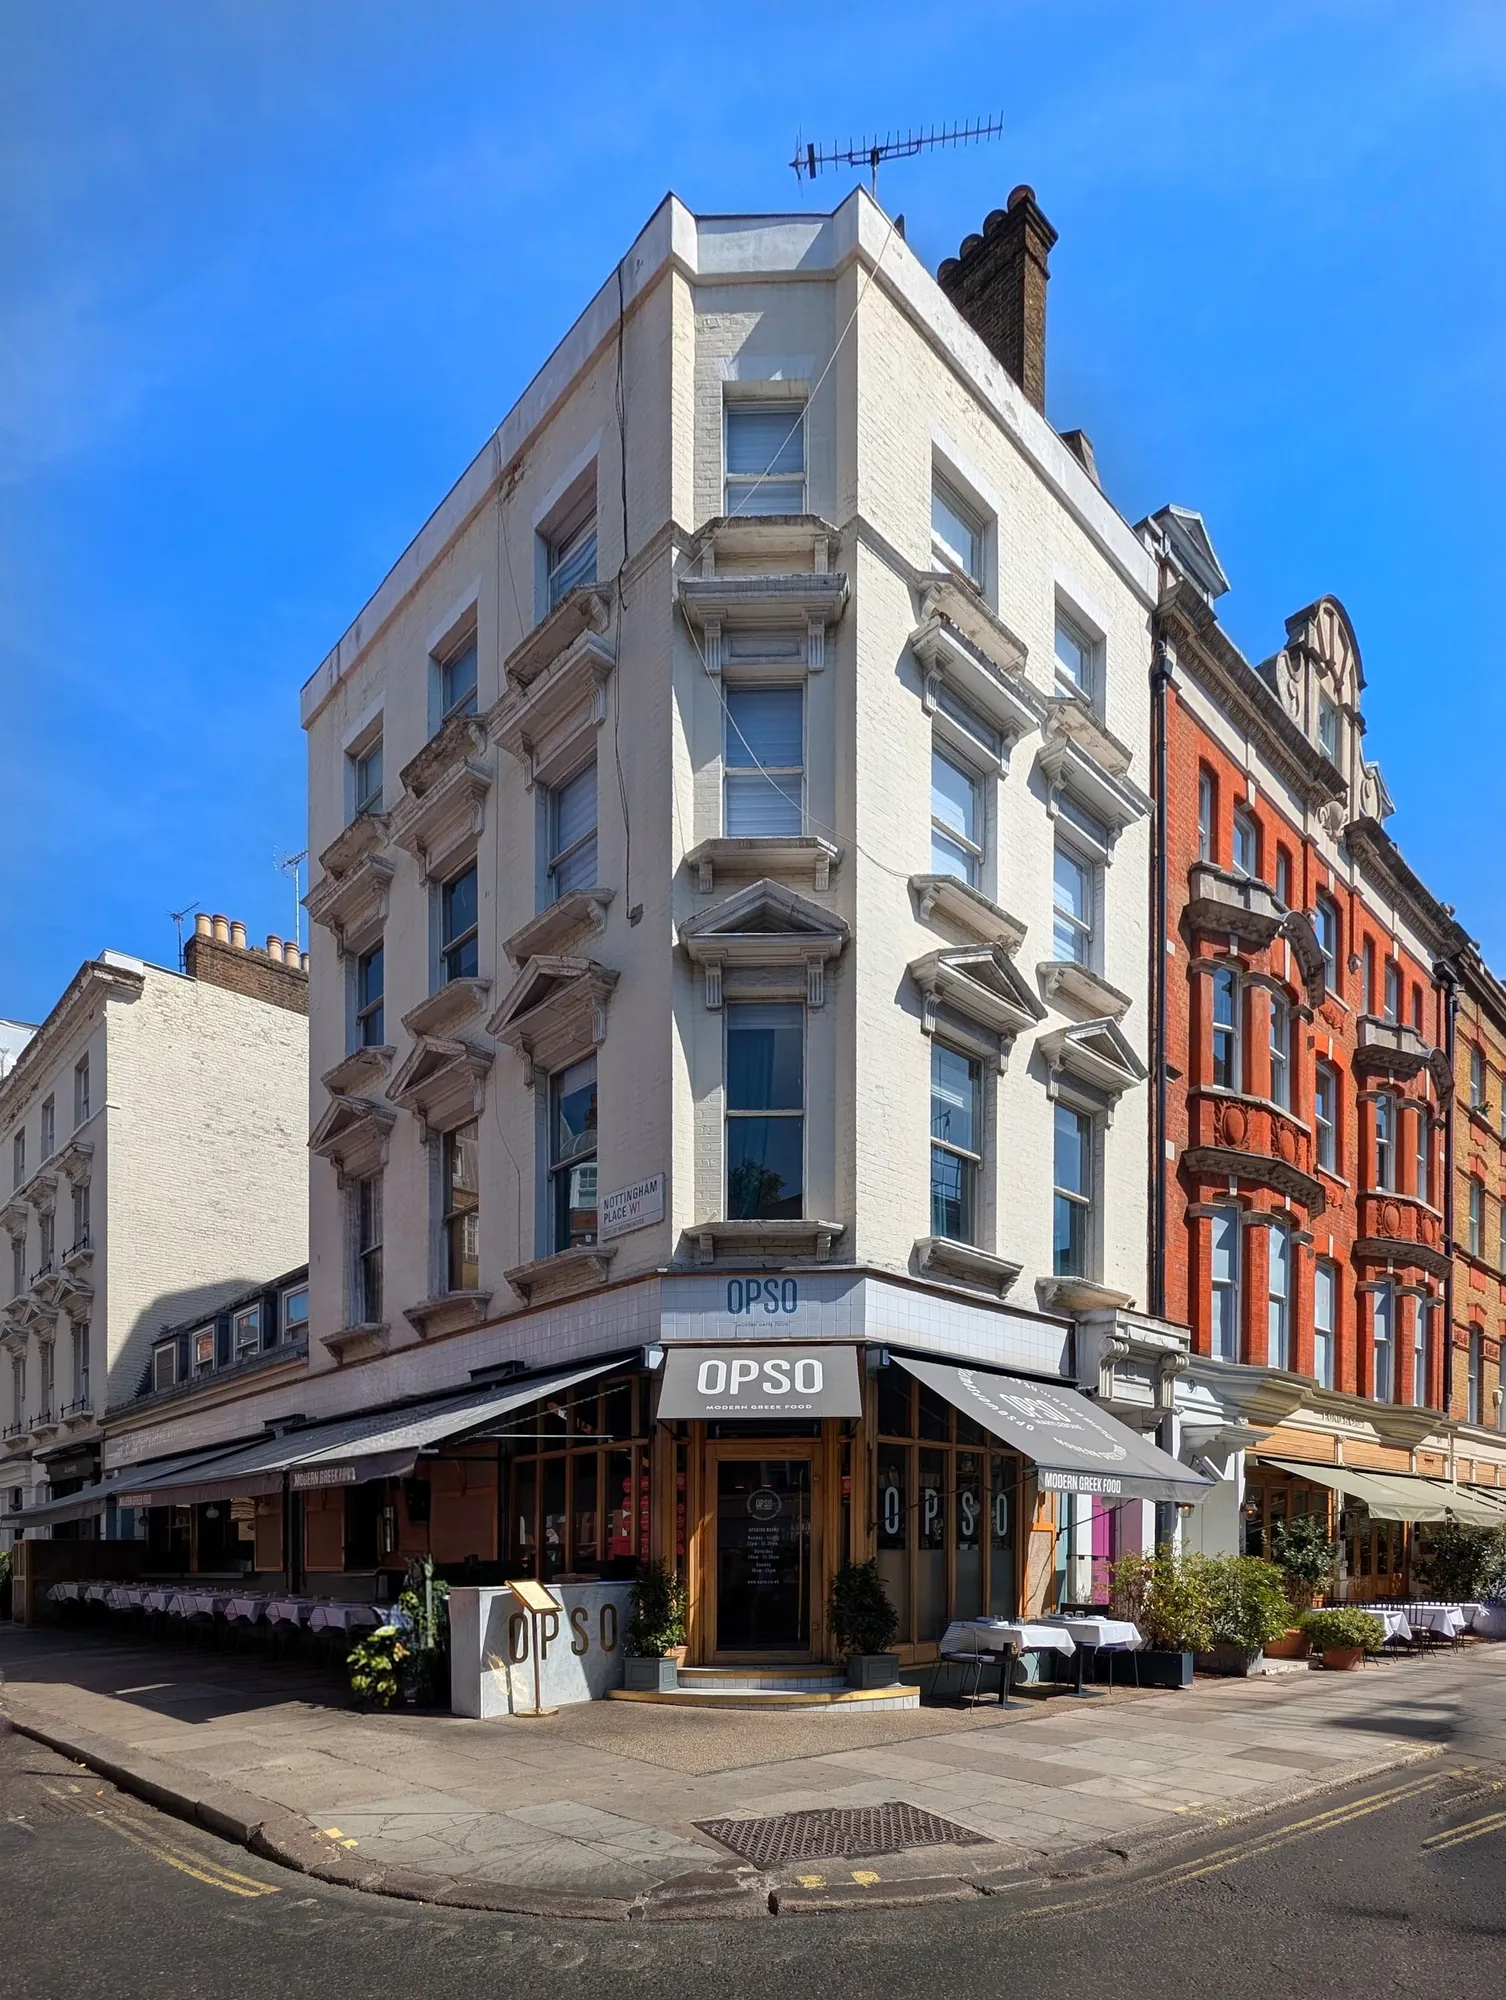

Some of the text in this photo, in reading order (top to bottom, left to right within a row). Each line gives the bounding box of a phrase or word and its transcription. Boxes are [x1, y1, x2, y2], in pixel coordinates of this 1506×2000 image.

[603, 1180, 658, 1210] NOTTINGHAM
[603, 1201, 641, 1225] PLACE W1
[727, 1278, 798, 1315] OPSO
[697, 1359, 824, 1395] OPSO
[999, 1393, 1072, 1422] OPSO
[293, 1471, 319, 1487] MODERN
[319, 1468, 339, 1484] GREEK
[1044, 1472, 1121, 1494] MODERN GREEK FOOD
[756, 1498, 772, 1508] OPSO
[508, 1603, 618, 1664] OPSO
